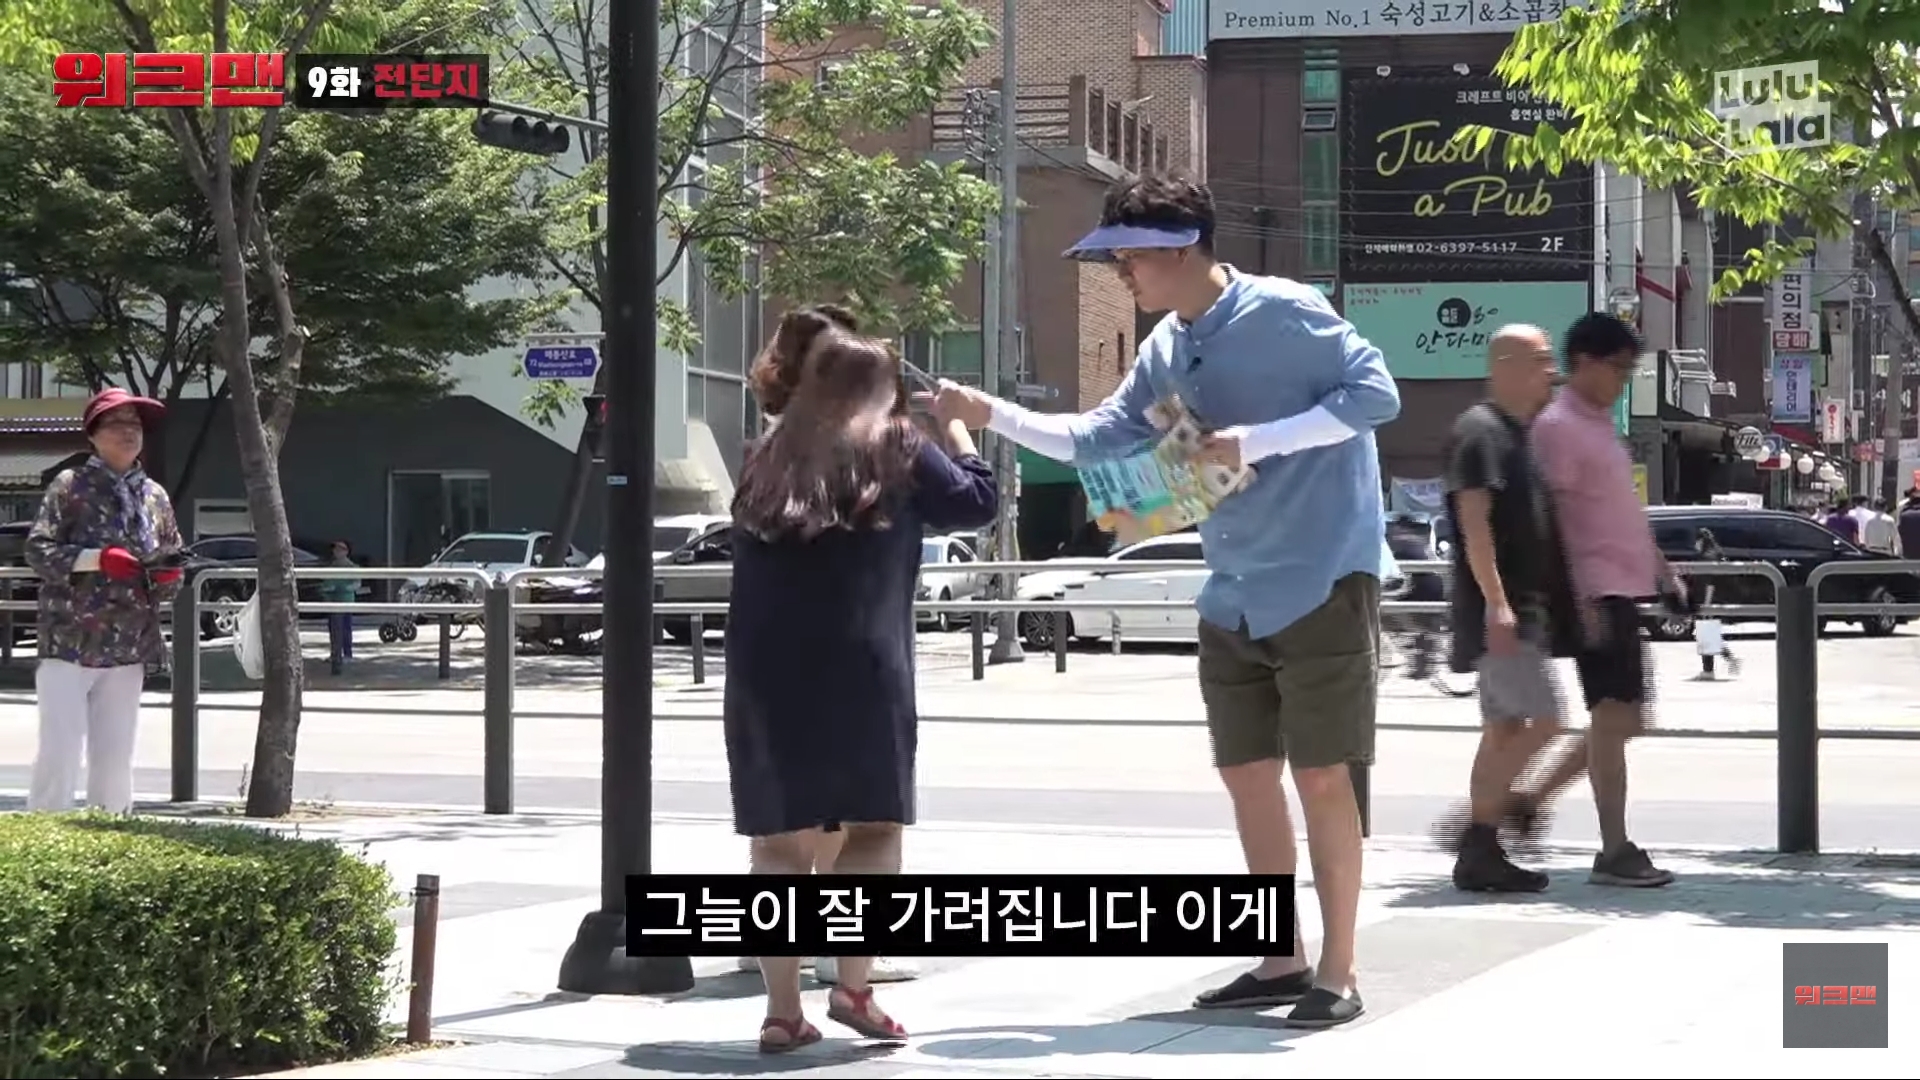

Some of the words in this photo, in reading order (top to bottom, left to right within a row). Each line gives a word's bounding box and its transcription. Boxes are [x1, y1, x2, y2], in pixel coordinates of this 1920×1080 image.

[1225, 11, 1315, 28] Premium
[1326, 10, 1371, 29] No.1
[1456, 90, 1503, 104] 크레프트
[1506, 90, 1530, 104] 비어
[1510, 108, 1542, 121] 흡연실
[1413, 193, 1446, 217] a
[1443, 175, 1553, 217] Pub
[1416, 242, 1517, 253] 02-6397-5117
[1541, 237, 1564, 252] 2F
[1782, 274, 1802, 329] 편의점
[1775, 333, 1808, 348] 담배
